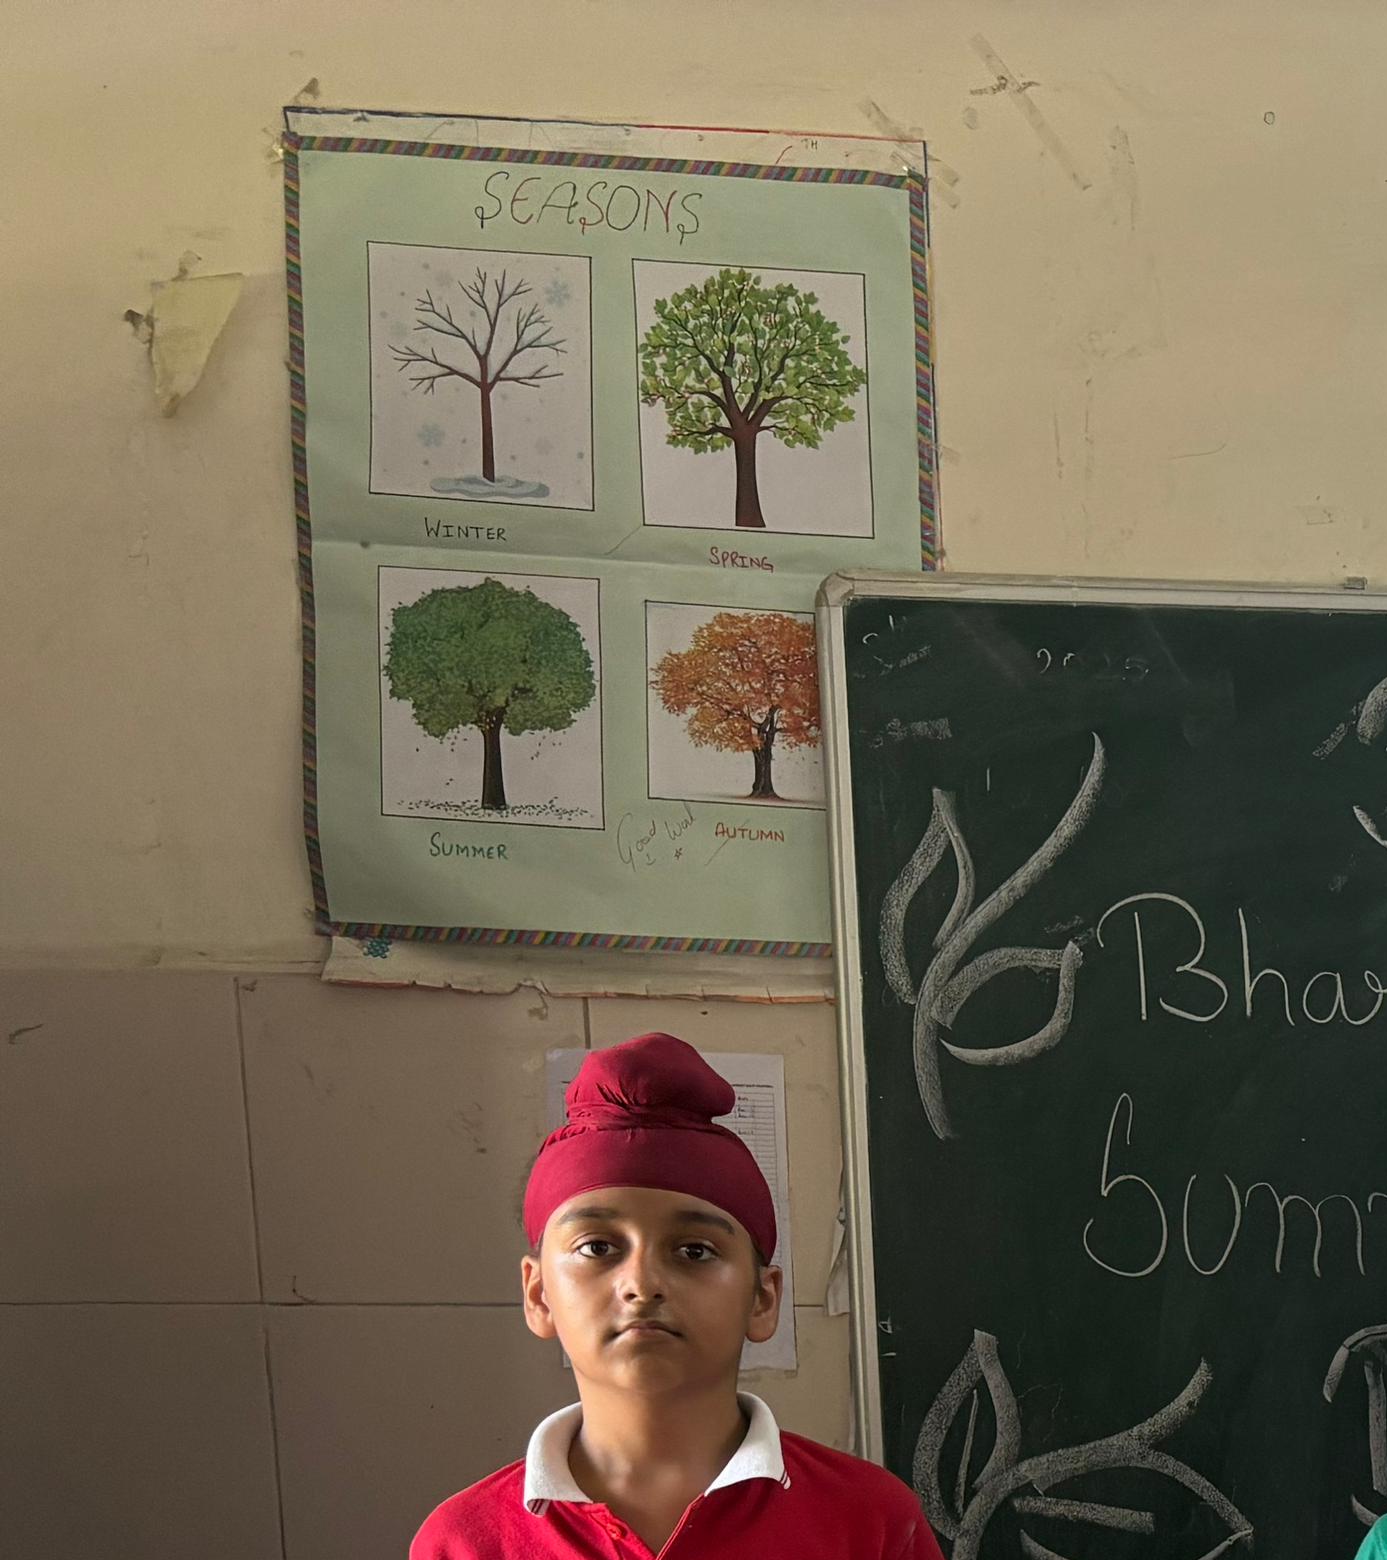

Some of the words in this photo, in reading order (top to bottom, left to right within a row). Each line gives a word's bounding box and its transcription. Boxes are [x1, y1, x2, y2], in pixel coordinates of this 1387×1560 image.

[474, 170, 703, 245] SEASONS
[424, 517, 507, 541] WINTER
[709, 546, 774, 574] SPRING
[429, 831, 508, 859] SUMMER
[714, 821, 785, 843] AUTUMN
